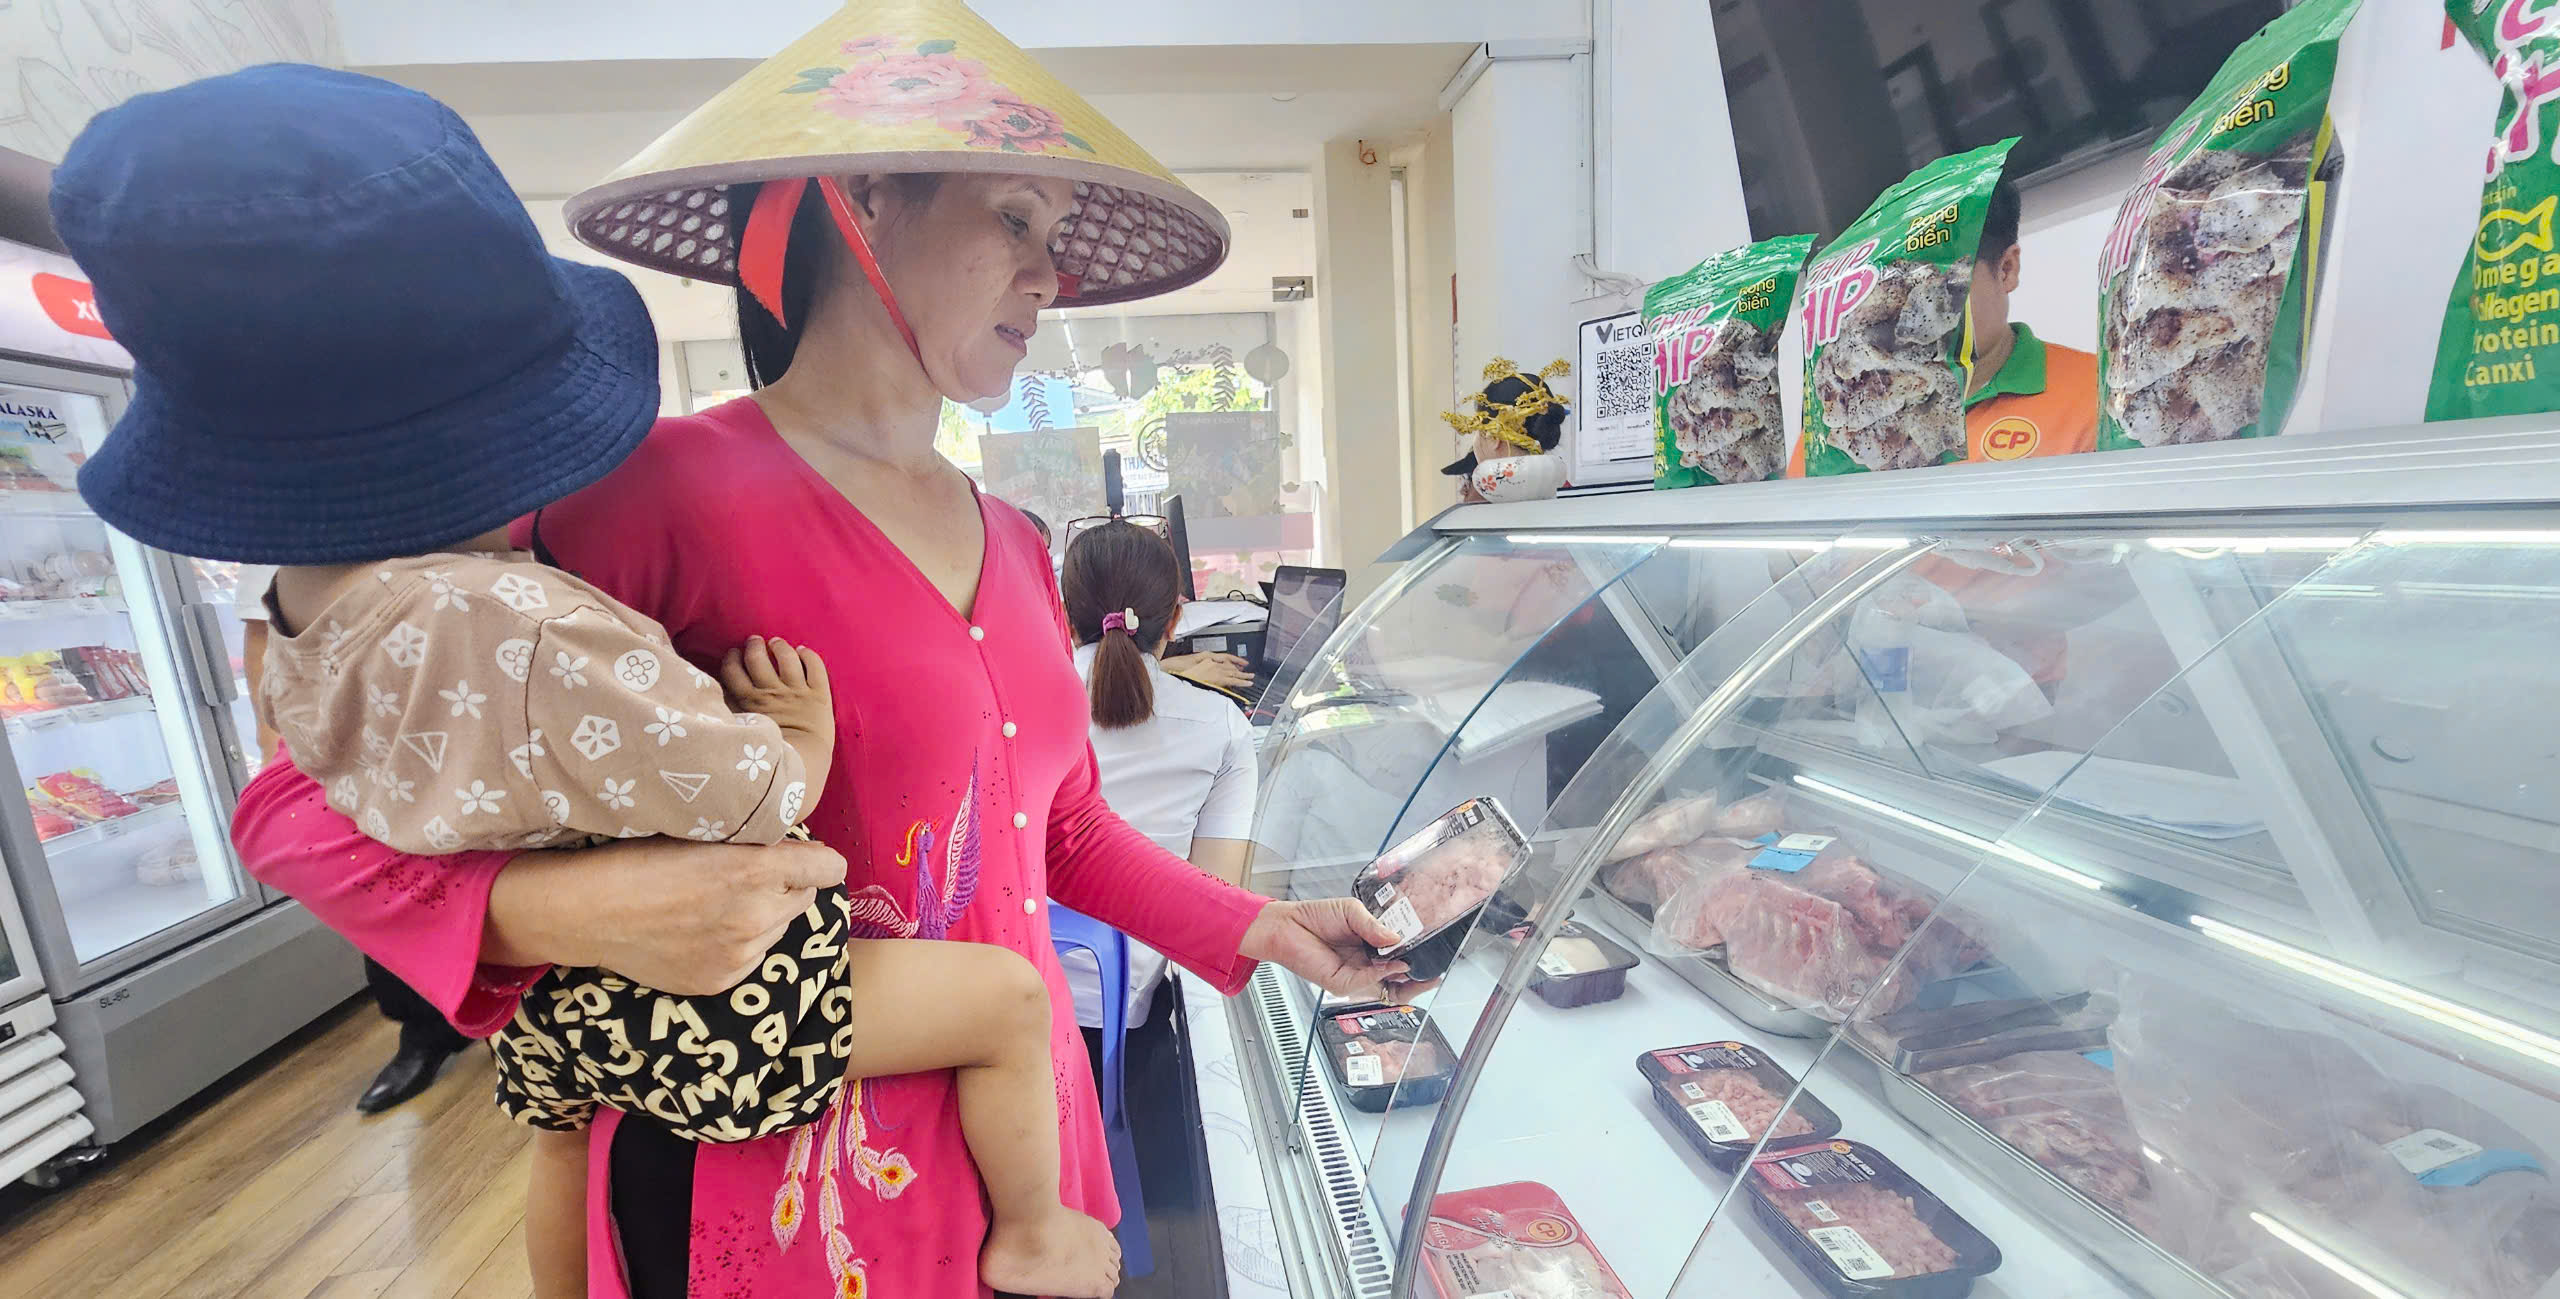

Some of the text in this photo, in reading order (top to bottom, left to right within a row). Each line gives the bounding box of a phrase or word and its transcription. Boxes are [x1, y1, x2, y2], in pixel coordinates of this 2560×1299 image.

[2473, 252, 2560, 291] Omega
[2471, 318, 2560, 354] rotein
[2464, 353, 2536, 387] Canxi
